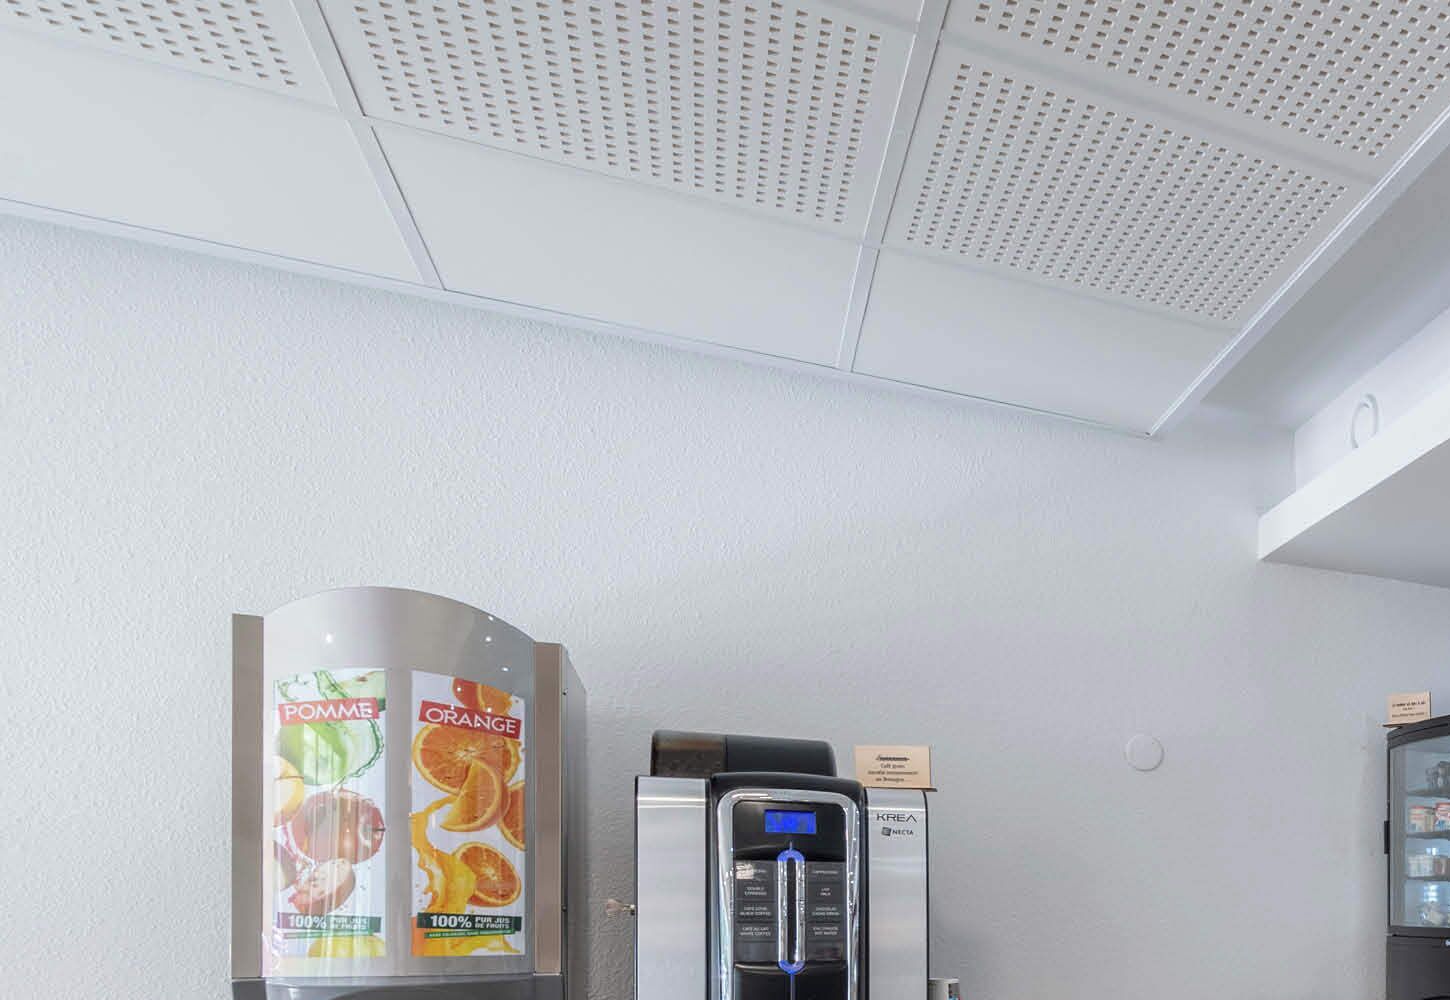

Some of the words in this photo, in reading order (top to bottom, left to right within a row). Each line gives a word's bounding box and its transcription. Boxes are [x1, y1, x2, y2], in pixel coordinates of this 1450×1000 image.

[283, 702, 373, 721] POMME
[425, 707, 516, 734] ORANGE
[876, 813, 917, 823] KREA
[892, 828, 914, 836] NECTA
[288, 914, 328, 929] 100%
[430, 914, 472, 929] 100%
